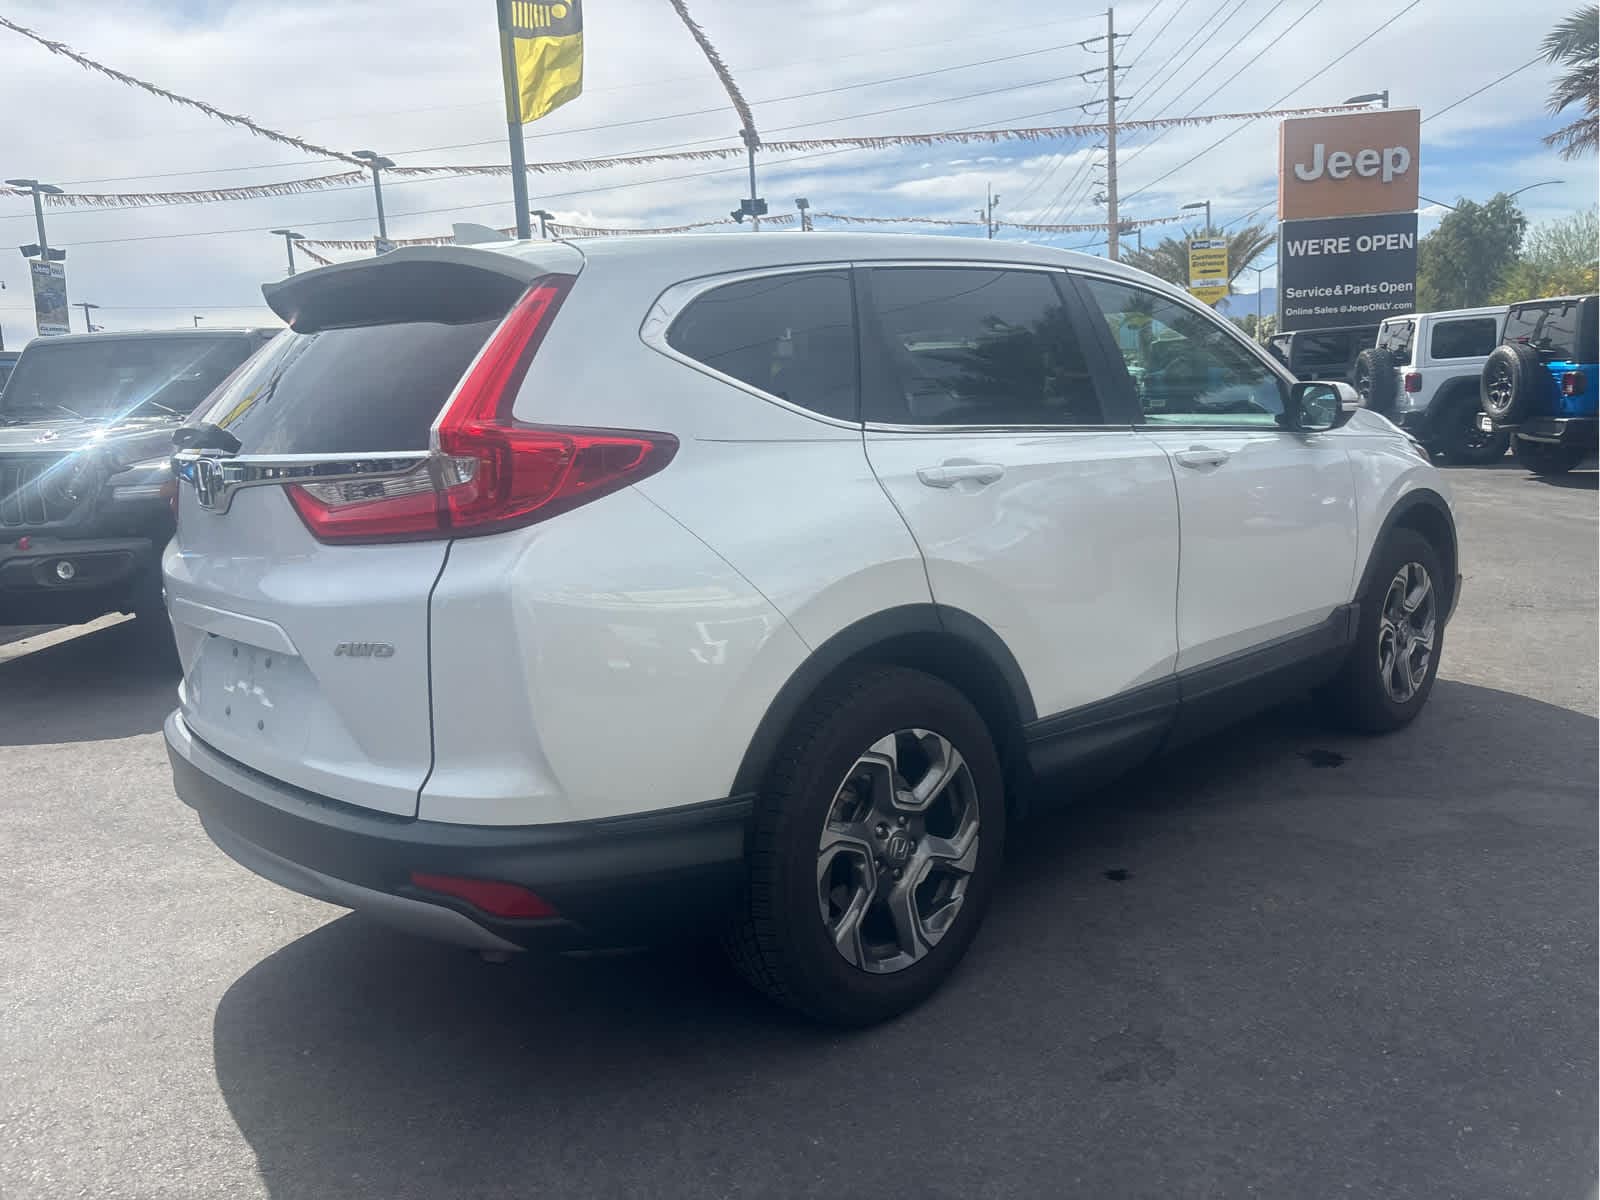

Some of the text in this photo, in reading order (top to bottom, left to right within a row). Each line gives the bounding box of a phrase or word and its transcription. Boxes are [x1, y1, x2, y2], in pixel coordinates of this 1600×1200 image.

[1294, 143, 1411, 183] Jeep
[1287, 232, 1414, 257] WE'RE OPEN
[1286, 286, 1333, 299] Service
[1344, 284, 1377, 295] Parts
[1379, 281, 1413, 294] Open
[1286, 302, 1413, 317] Online Sales @JeepONLY.com
[333, 640, 395, 657] AWD
